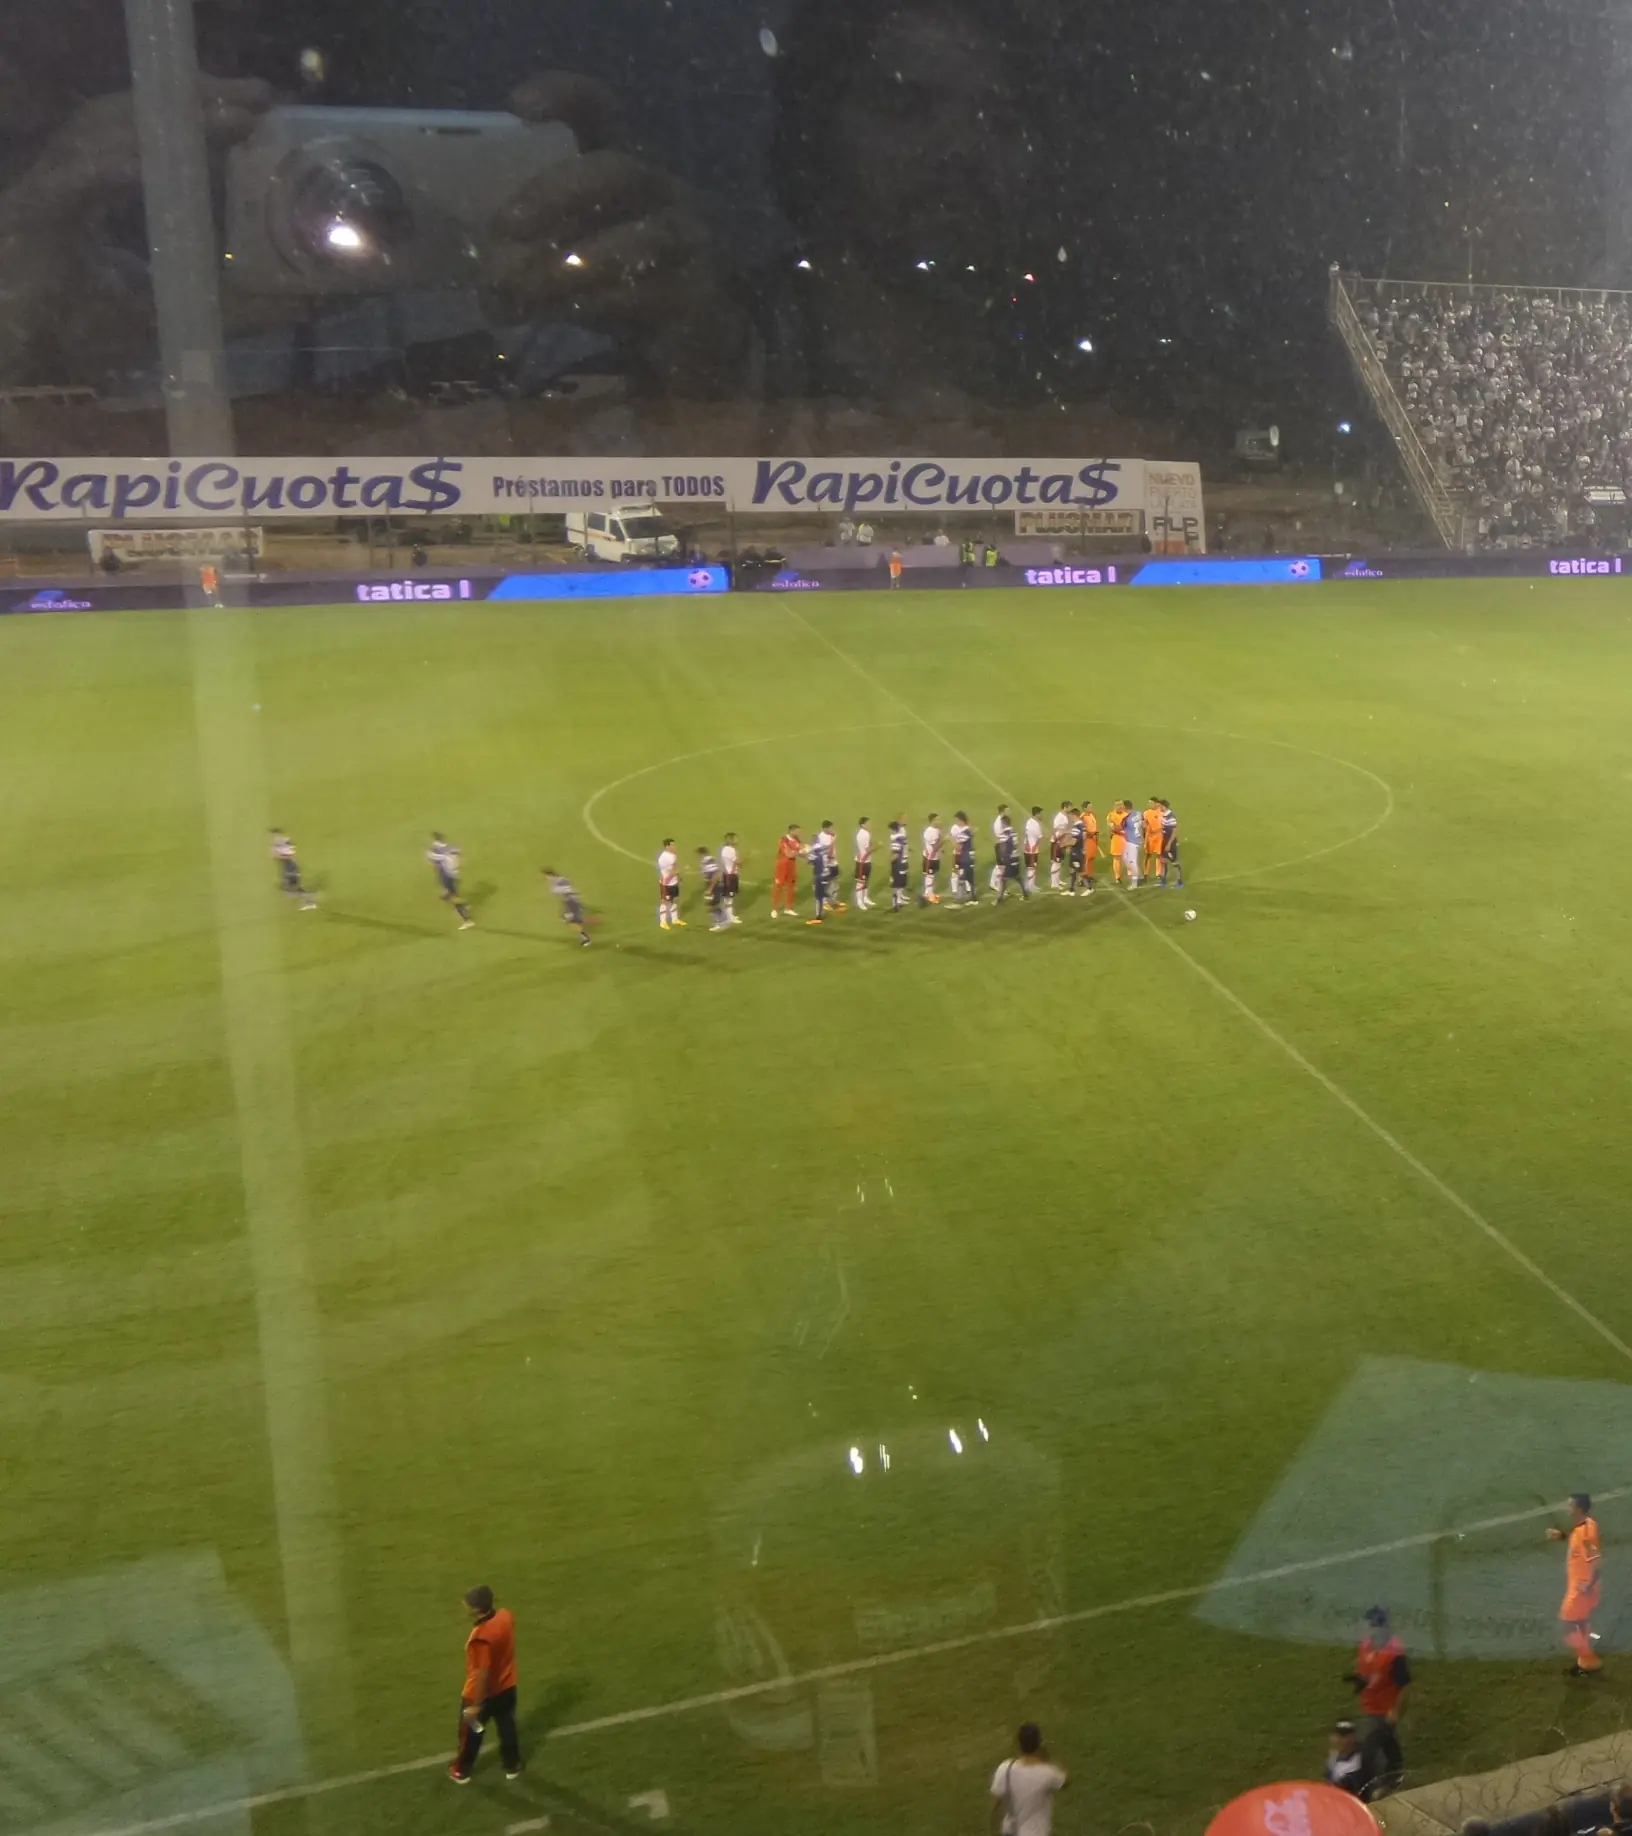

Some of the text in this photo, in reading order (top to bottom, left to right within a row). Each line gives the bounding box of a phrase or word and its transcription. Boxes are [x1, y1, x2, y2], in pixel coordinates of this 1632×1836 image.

[0, 457, 463, 518] RapiCuota$
[493, 475, 725, 499] Préstamos para TODOS
[752, 457, 1121, 513] RapiCuota$
[1026, 567, 1101, 585] tatica
[1549, 558, 1610, 575] tatica
[357, 580, 451, 602] tatica
